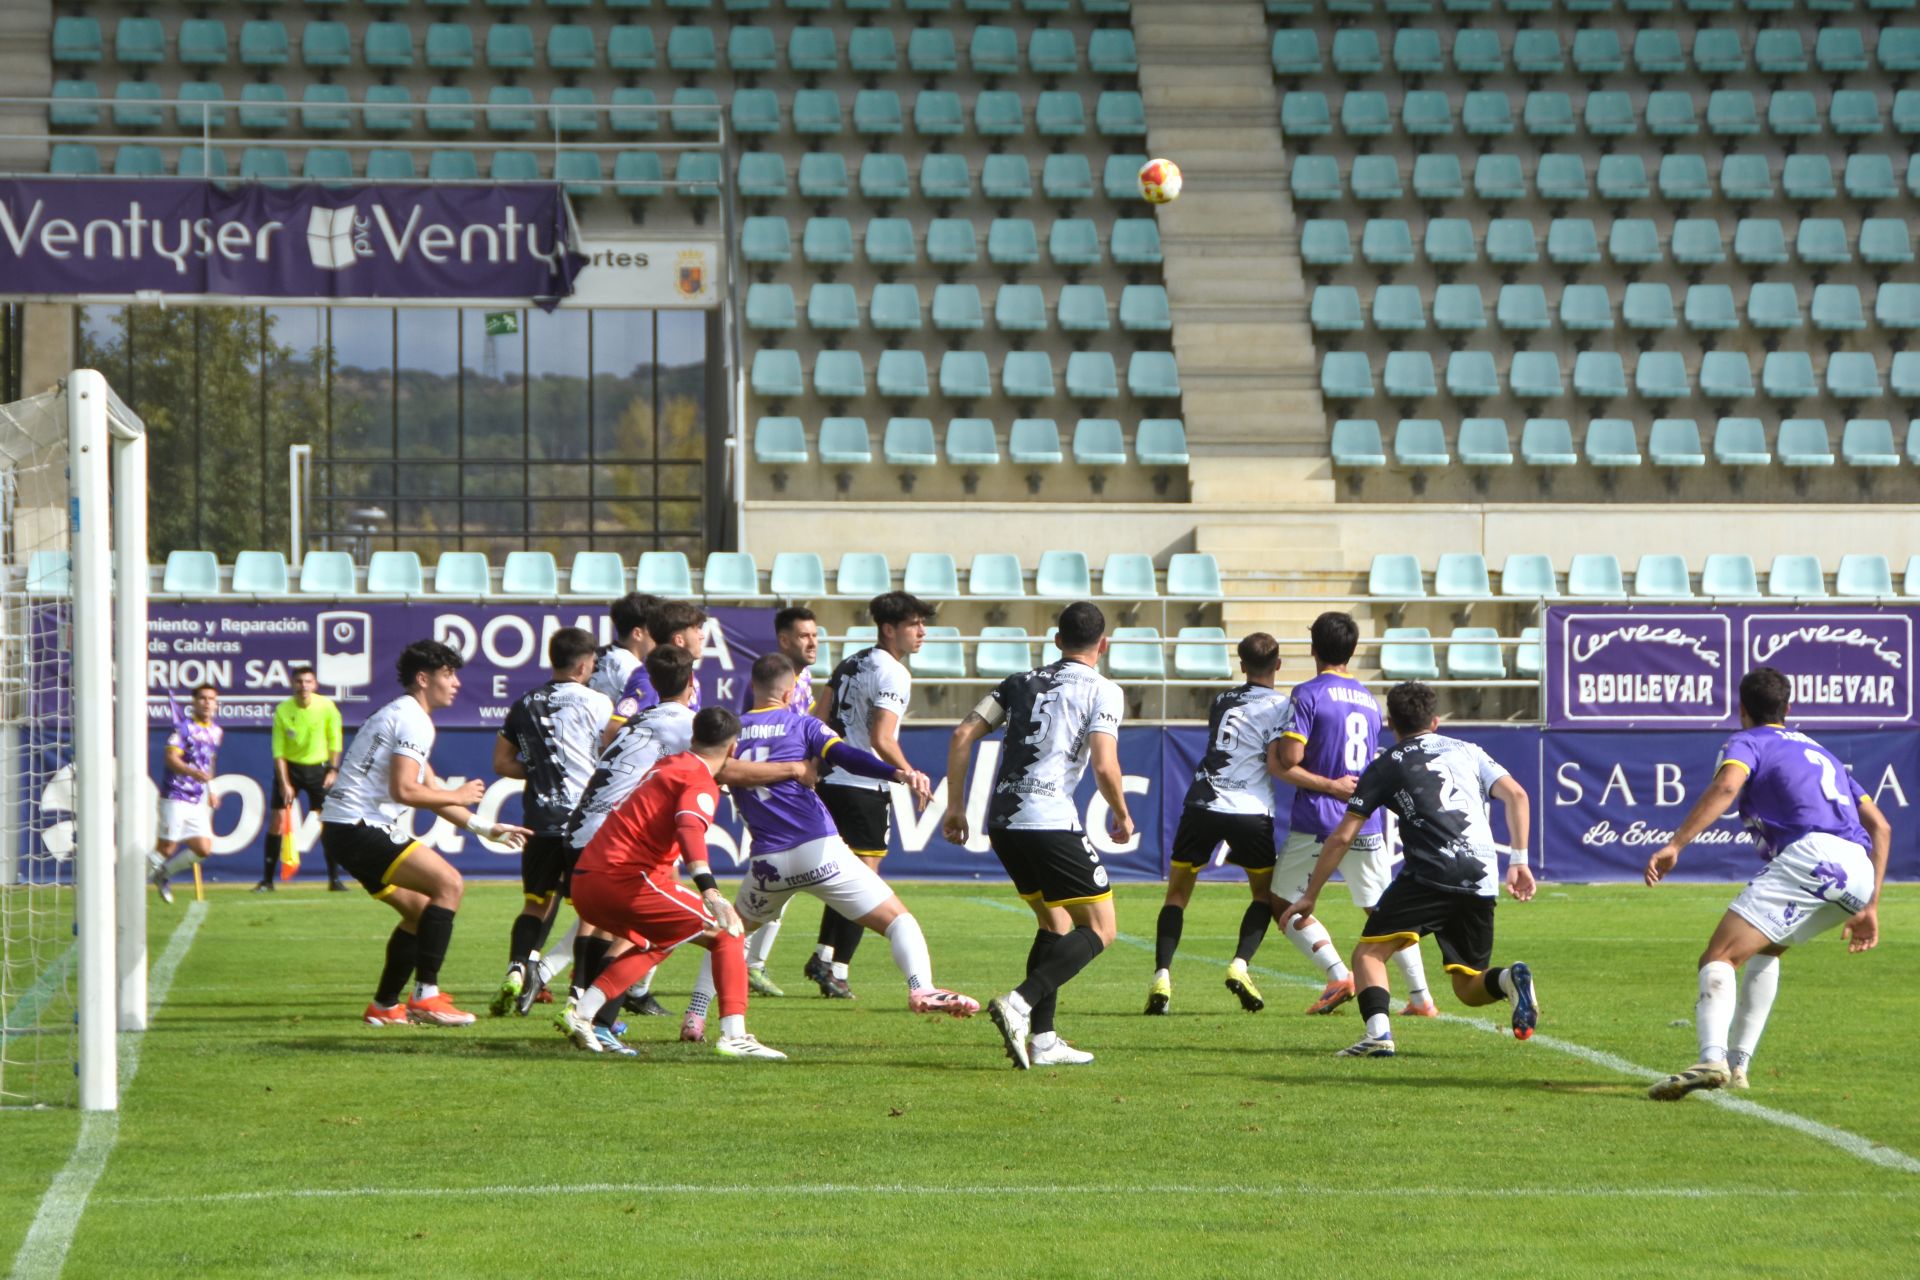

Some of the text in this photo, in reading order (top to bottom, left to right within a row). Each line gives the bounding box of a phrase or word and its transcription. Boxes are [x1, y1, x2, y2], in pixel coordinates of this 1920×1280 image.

[0, 198, 284, 275] Ventyser
[371, 203, 564, 276] Venty
[148, 637, 242, 653] de Calderas
[205, 620, 217, 636] y
[221, 616, 309, 636] Reparación
[245, 659, 312, 689] SA
[1578, 673, 1714, 706] BOULEVAR
[1784, 674, 1896, 707] ULEVAR
[1024, 691, 1060, 745] 5
[1215, 706, 1246, 752] 6
[1344, 711, 1369, 772] 8
[1425, 762, 1469, 812] 2
[1804, 748, 1852, 806] 2
[1583, 820, 1618, 846] La
[784, 860, 840, 887] TECNICAMPO
